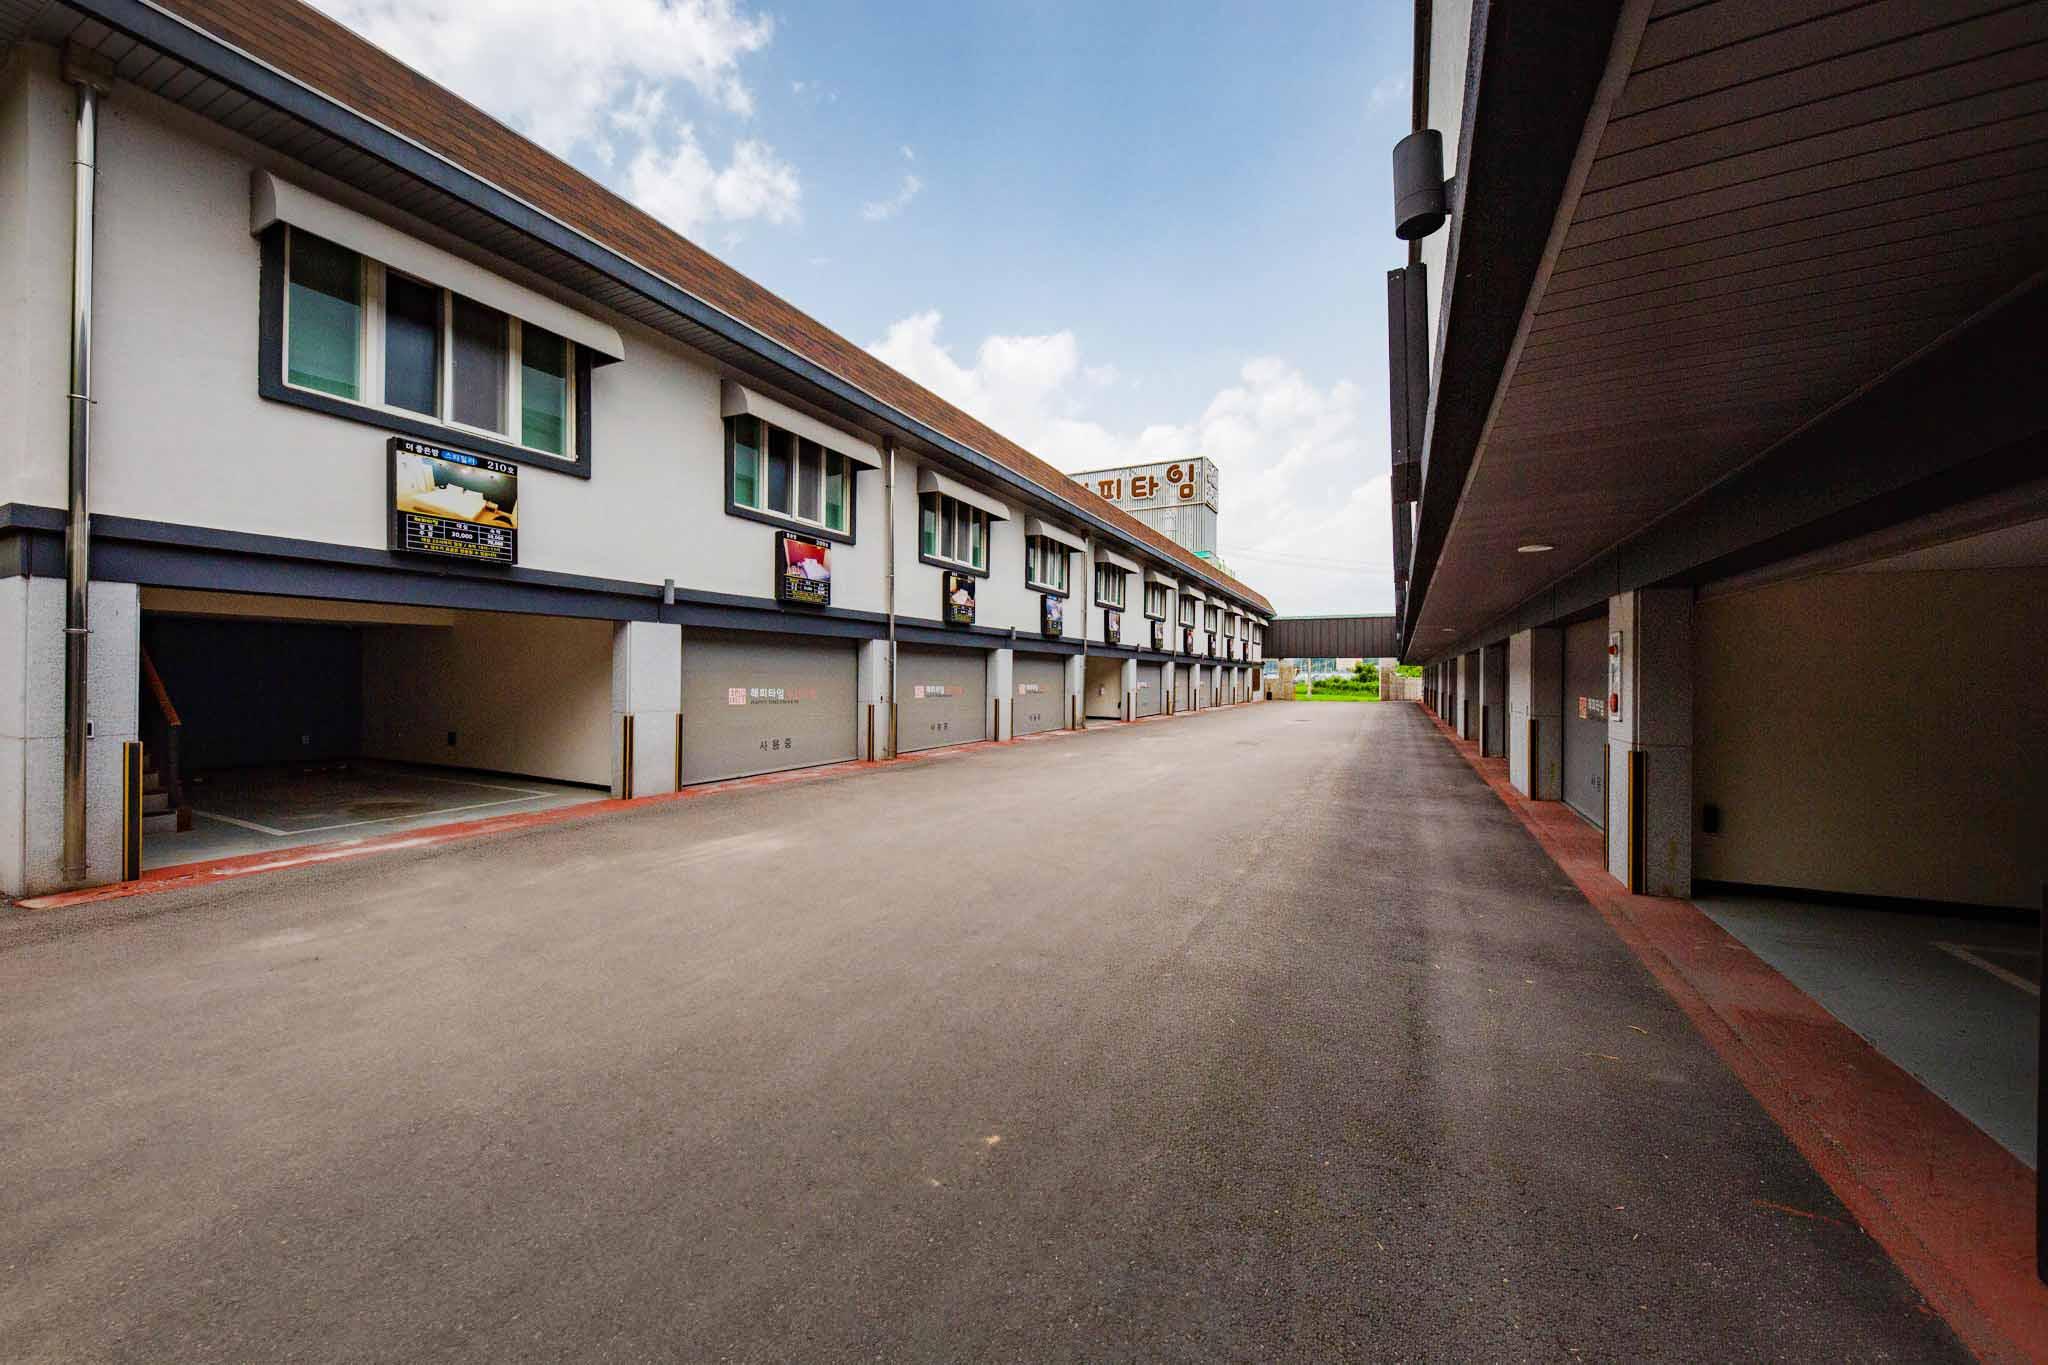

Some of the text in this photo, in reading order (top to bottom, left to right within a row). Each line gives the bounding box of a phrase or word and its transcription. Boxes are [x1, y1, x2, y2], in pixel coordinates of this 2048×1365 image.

[487, 461, 514, 475] 210호
[1084, 463, 1195, 500] 피타임
[750, 688, 784, 700] 해피타임
